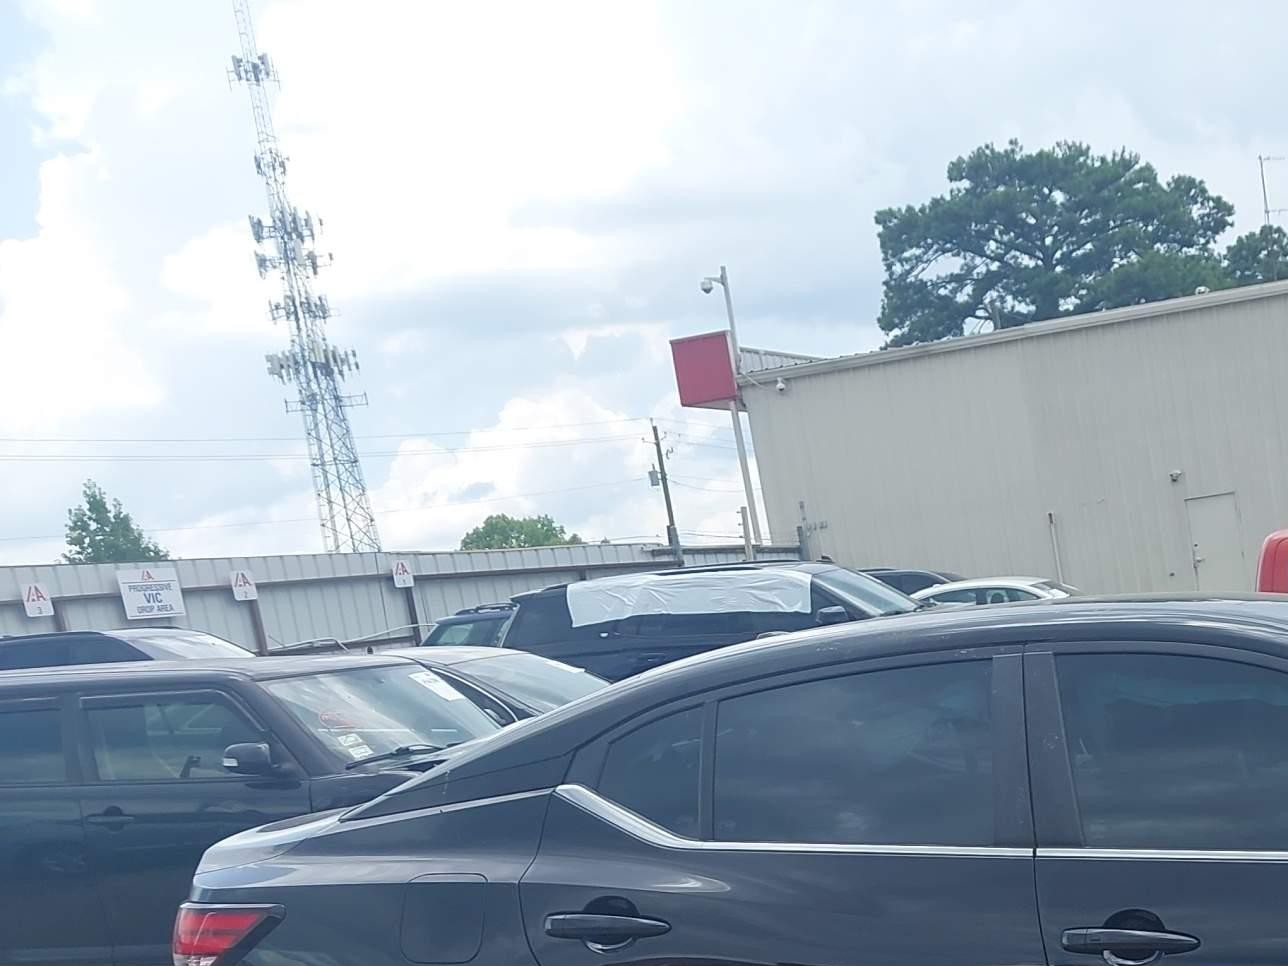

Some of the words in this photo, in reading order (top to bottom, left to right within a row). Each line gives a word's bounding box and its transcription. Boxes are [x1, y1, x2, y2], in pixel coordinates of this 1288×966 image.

[127, 583, 173, 592] PROGRESSIVE
[143, 592, 163, 604] VIC
[136, 605, 155, 613] DROP
[157, 603, 175, 612] AREA
